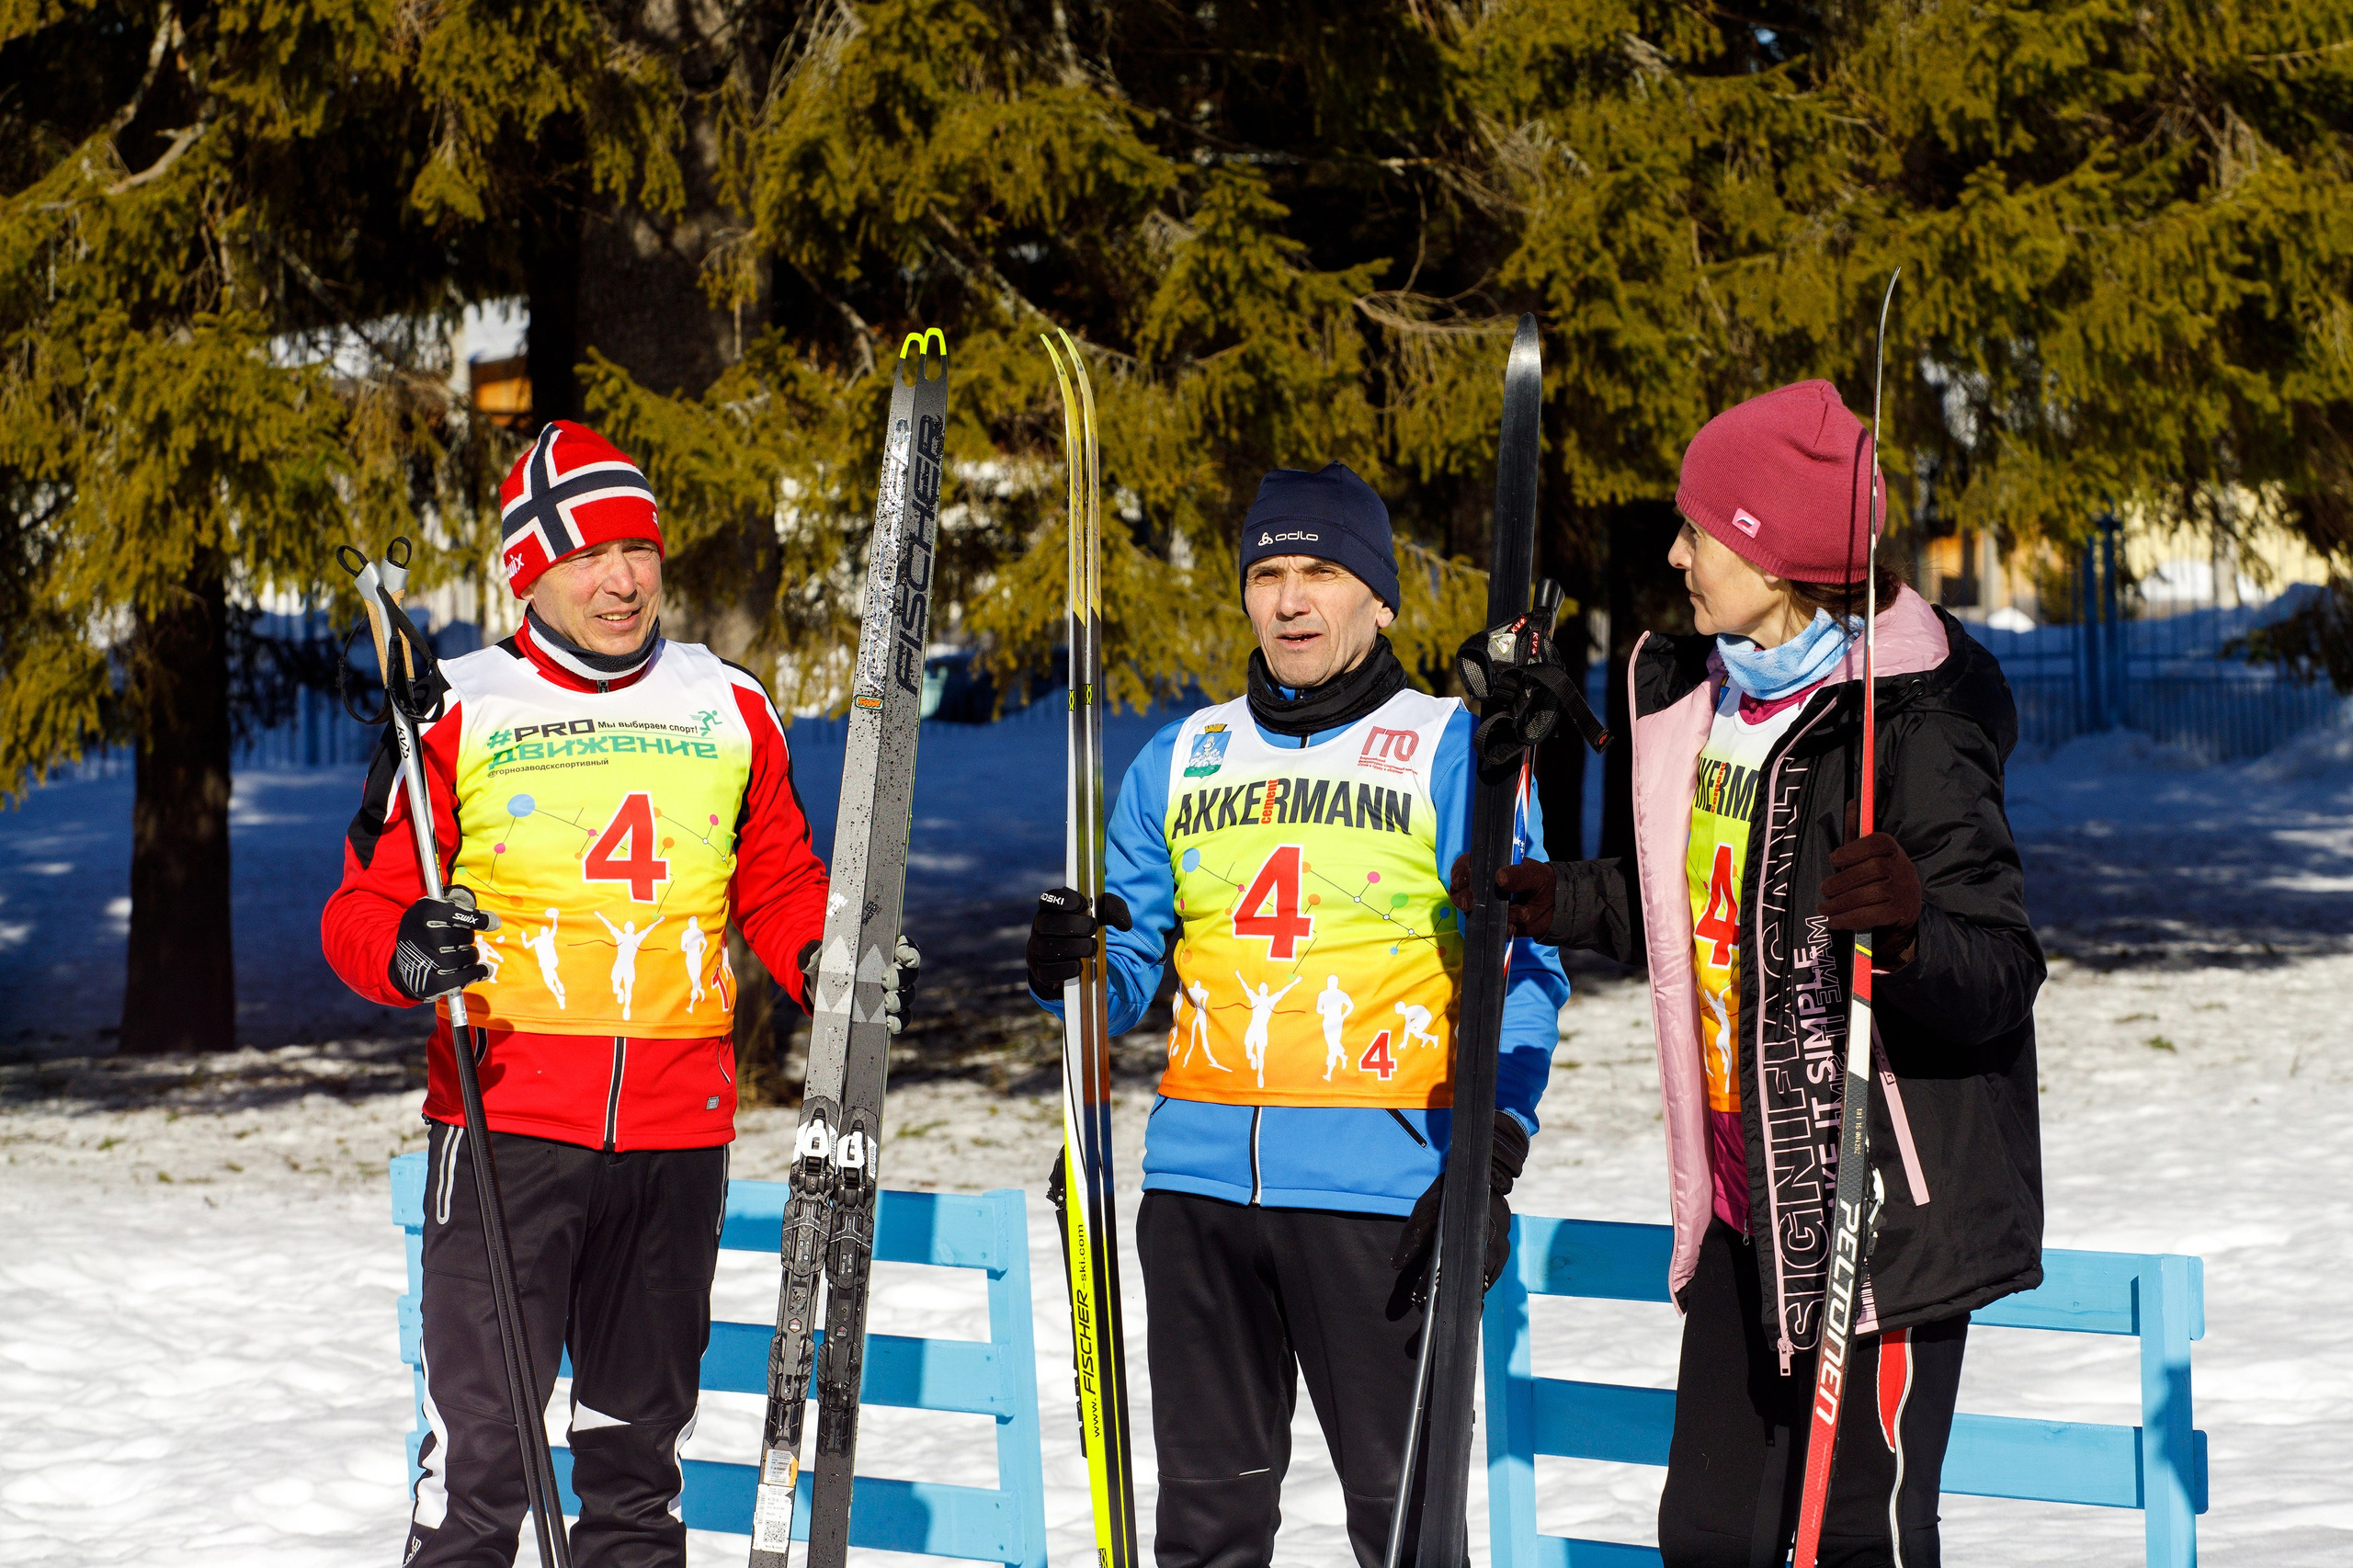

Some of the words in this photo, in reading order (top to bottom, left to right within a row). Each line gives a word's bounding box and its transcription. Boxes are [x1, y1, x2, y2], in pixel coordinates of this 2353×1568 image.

[1072, 435, 1083, 605] FISCHER
[1275, 530, 1319, 541] odlo
[895, 415, 944, 696] FISCHER
[597, 720, 616, 729] Мы
[619, 720, 666, 733] выбираем
[669, 722, 699, 734] спорт!
[1361, 725, 1420, 762] ГТО
[487, 758, 609, 778] @горнозаводскспортивный
[1171, 778, 1413, 840] AKKERMANN
[1260, 778, 1279, 824] cement
[582, 791, 671, 905] 4
[1231, 843, 1316, 961] 4
[1694, 842, 1740, 970] 4
[1793, 946, 1836, 1085] SIMPLE
[1358, 1029, 1398, 1081] 4
